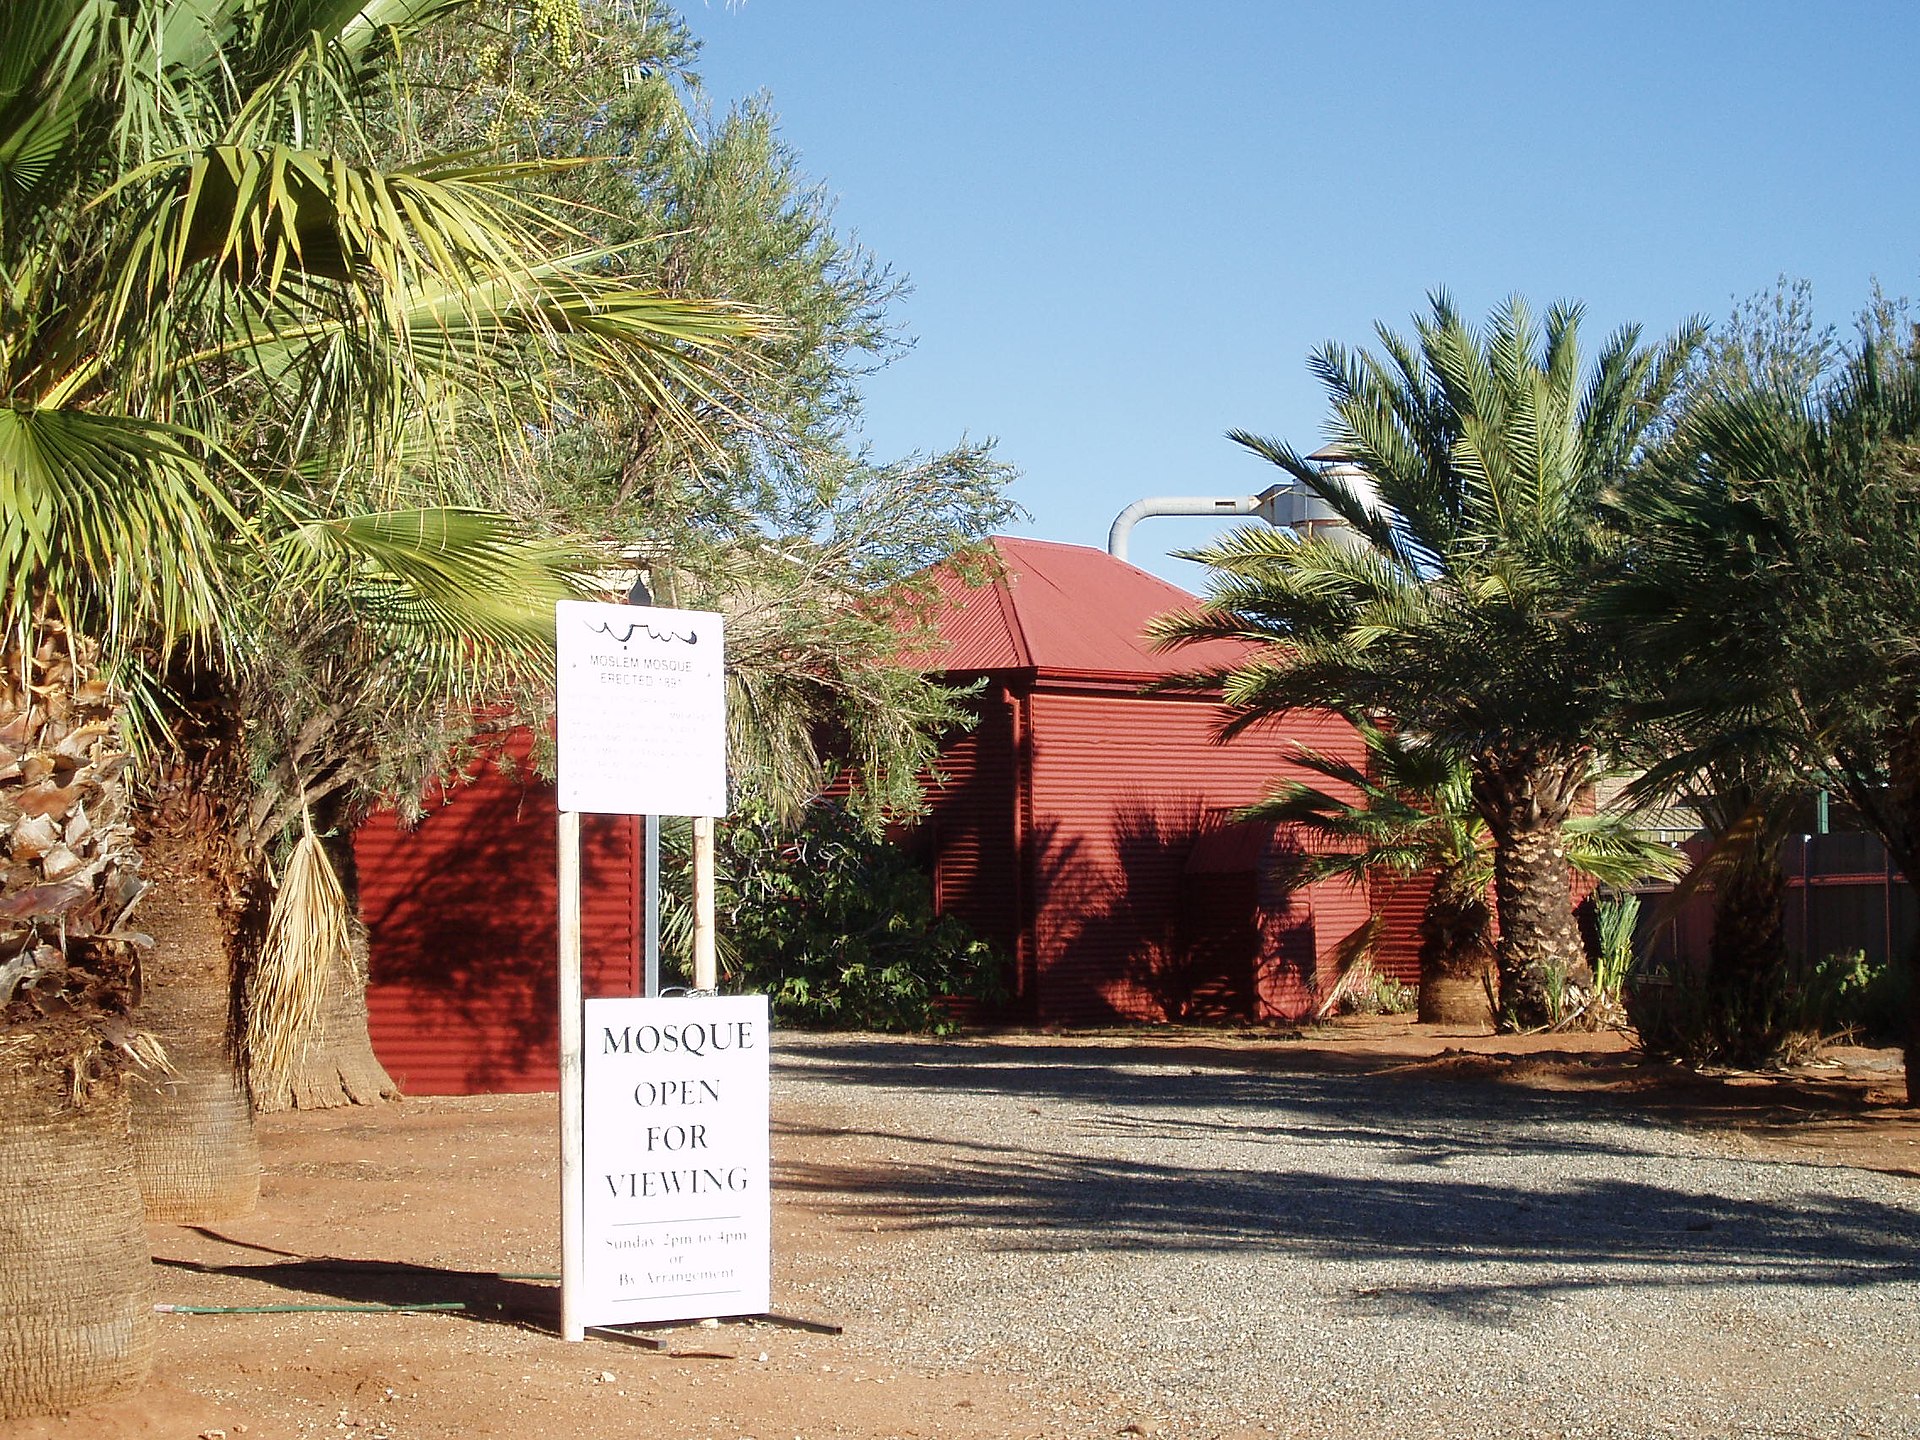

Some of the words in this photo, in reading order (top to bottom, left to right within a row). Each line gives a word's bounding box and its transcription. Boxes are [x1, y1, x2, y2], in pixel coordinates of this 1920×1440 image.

[590, 655, 639, 668] MOSLEM
[644, 659, 693, 672] MOSQUE
[601, 672, 653, 687] ERECTED
[602, 1022, 755, 1056] MOSQUE
[633, 1079, 720, 1107] OPEN
[646, 1124, 708, 1151] FOR
[605, 1166, 748, 1198] VIEWING
[604, 1233, 655, 1250] Sunday
[663, 1232, 692, 1248] 2pm
[698, 1233, 712, 1245] to
[716, 1231, 748, 1245] 4pm
[669, 1255, 684, 1265] or
[618, 1272, 635, 1287] By
[647, 1267, 735, 1285] Arrangement
